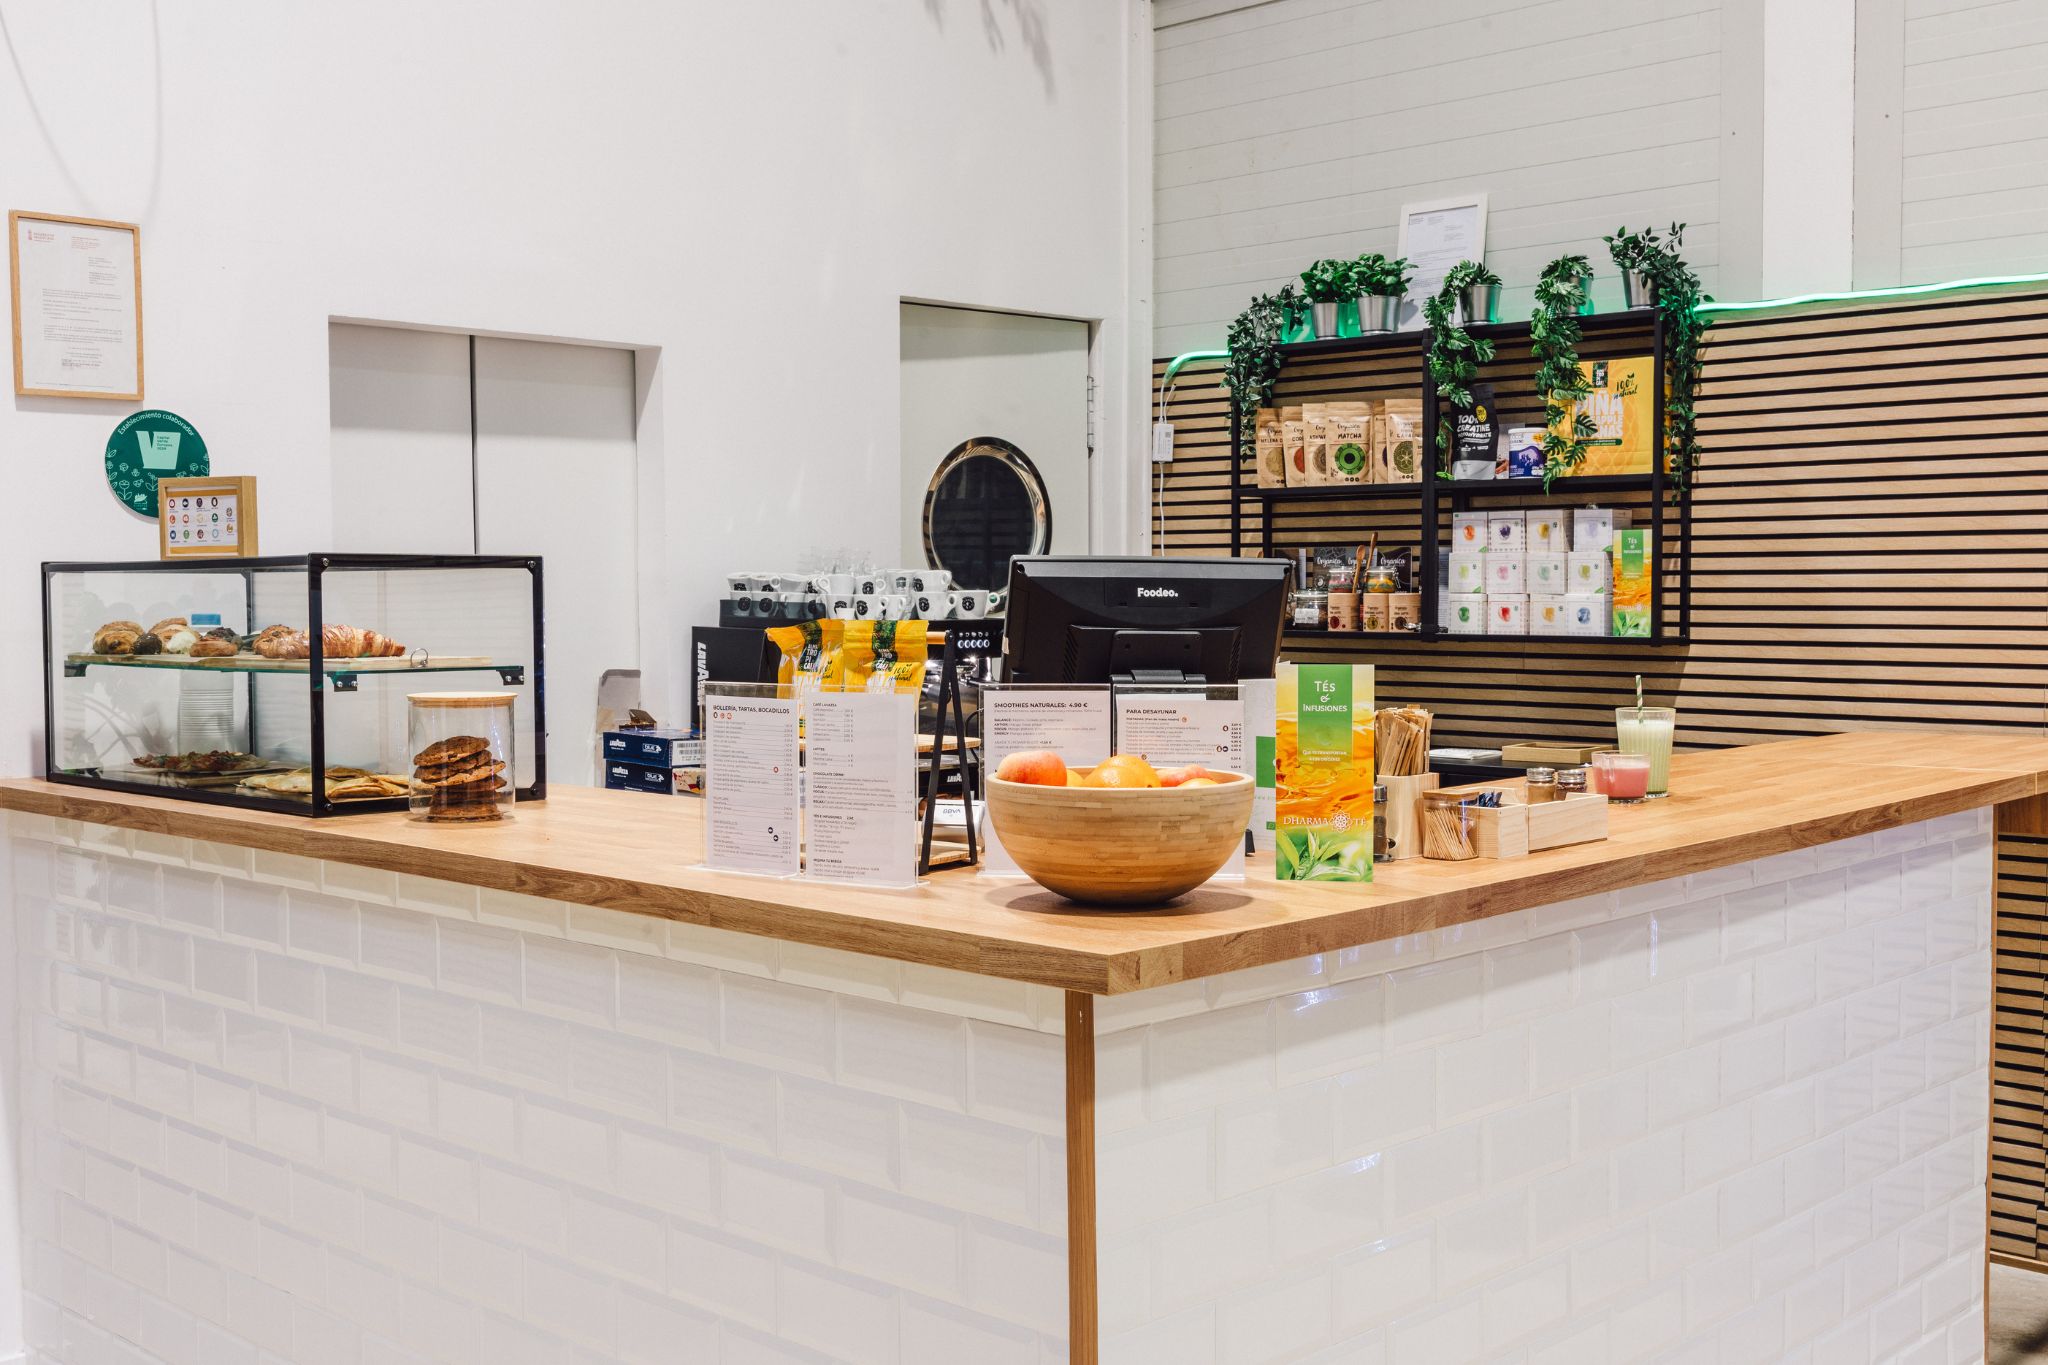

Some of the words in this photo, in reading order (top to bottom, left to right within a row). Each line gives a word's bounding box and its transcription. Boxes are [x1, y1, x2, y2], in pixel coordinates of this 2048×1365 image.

[1576, 390, 1622, 416] PIÑA
[118, 412, 162, 435] Establecimiento
[162, 413, 194, 436] colaborador
[1457, 424, 1490, 432] CREATINE
[1320, 694, 1330, 702] &
[1283, 817, 1328, 825] DHARMA
